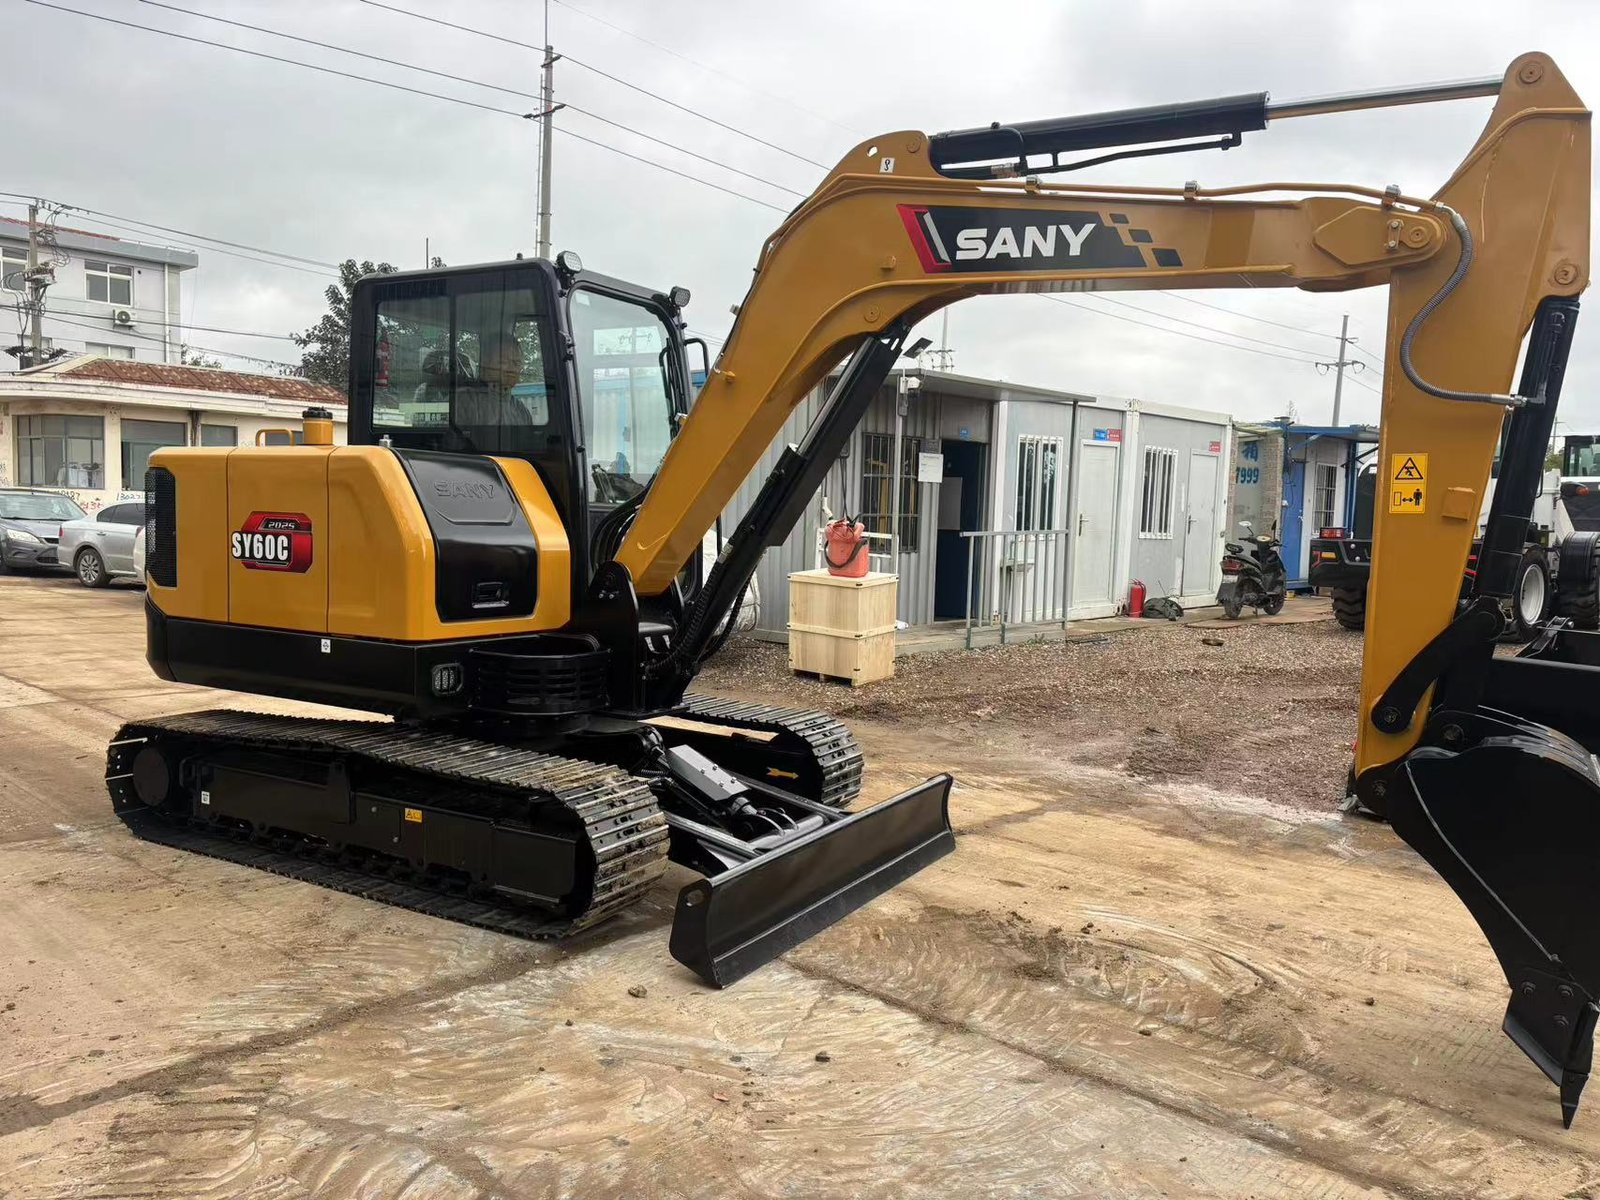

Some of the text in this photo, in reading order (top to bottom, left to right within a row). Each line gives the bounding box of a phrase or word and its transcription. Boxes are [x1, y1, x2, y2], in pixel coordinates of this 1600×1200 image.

[955, 223, 1097, 260] SANY
[433, 480, 494, 499] SANY
[268, 521, 295, 529] 2025
[232, 532, 288, 560] SY60C
